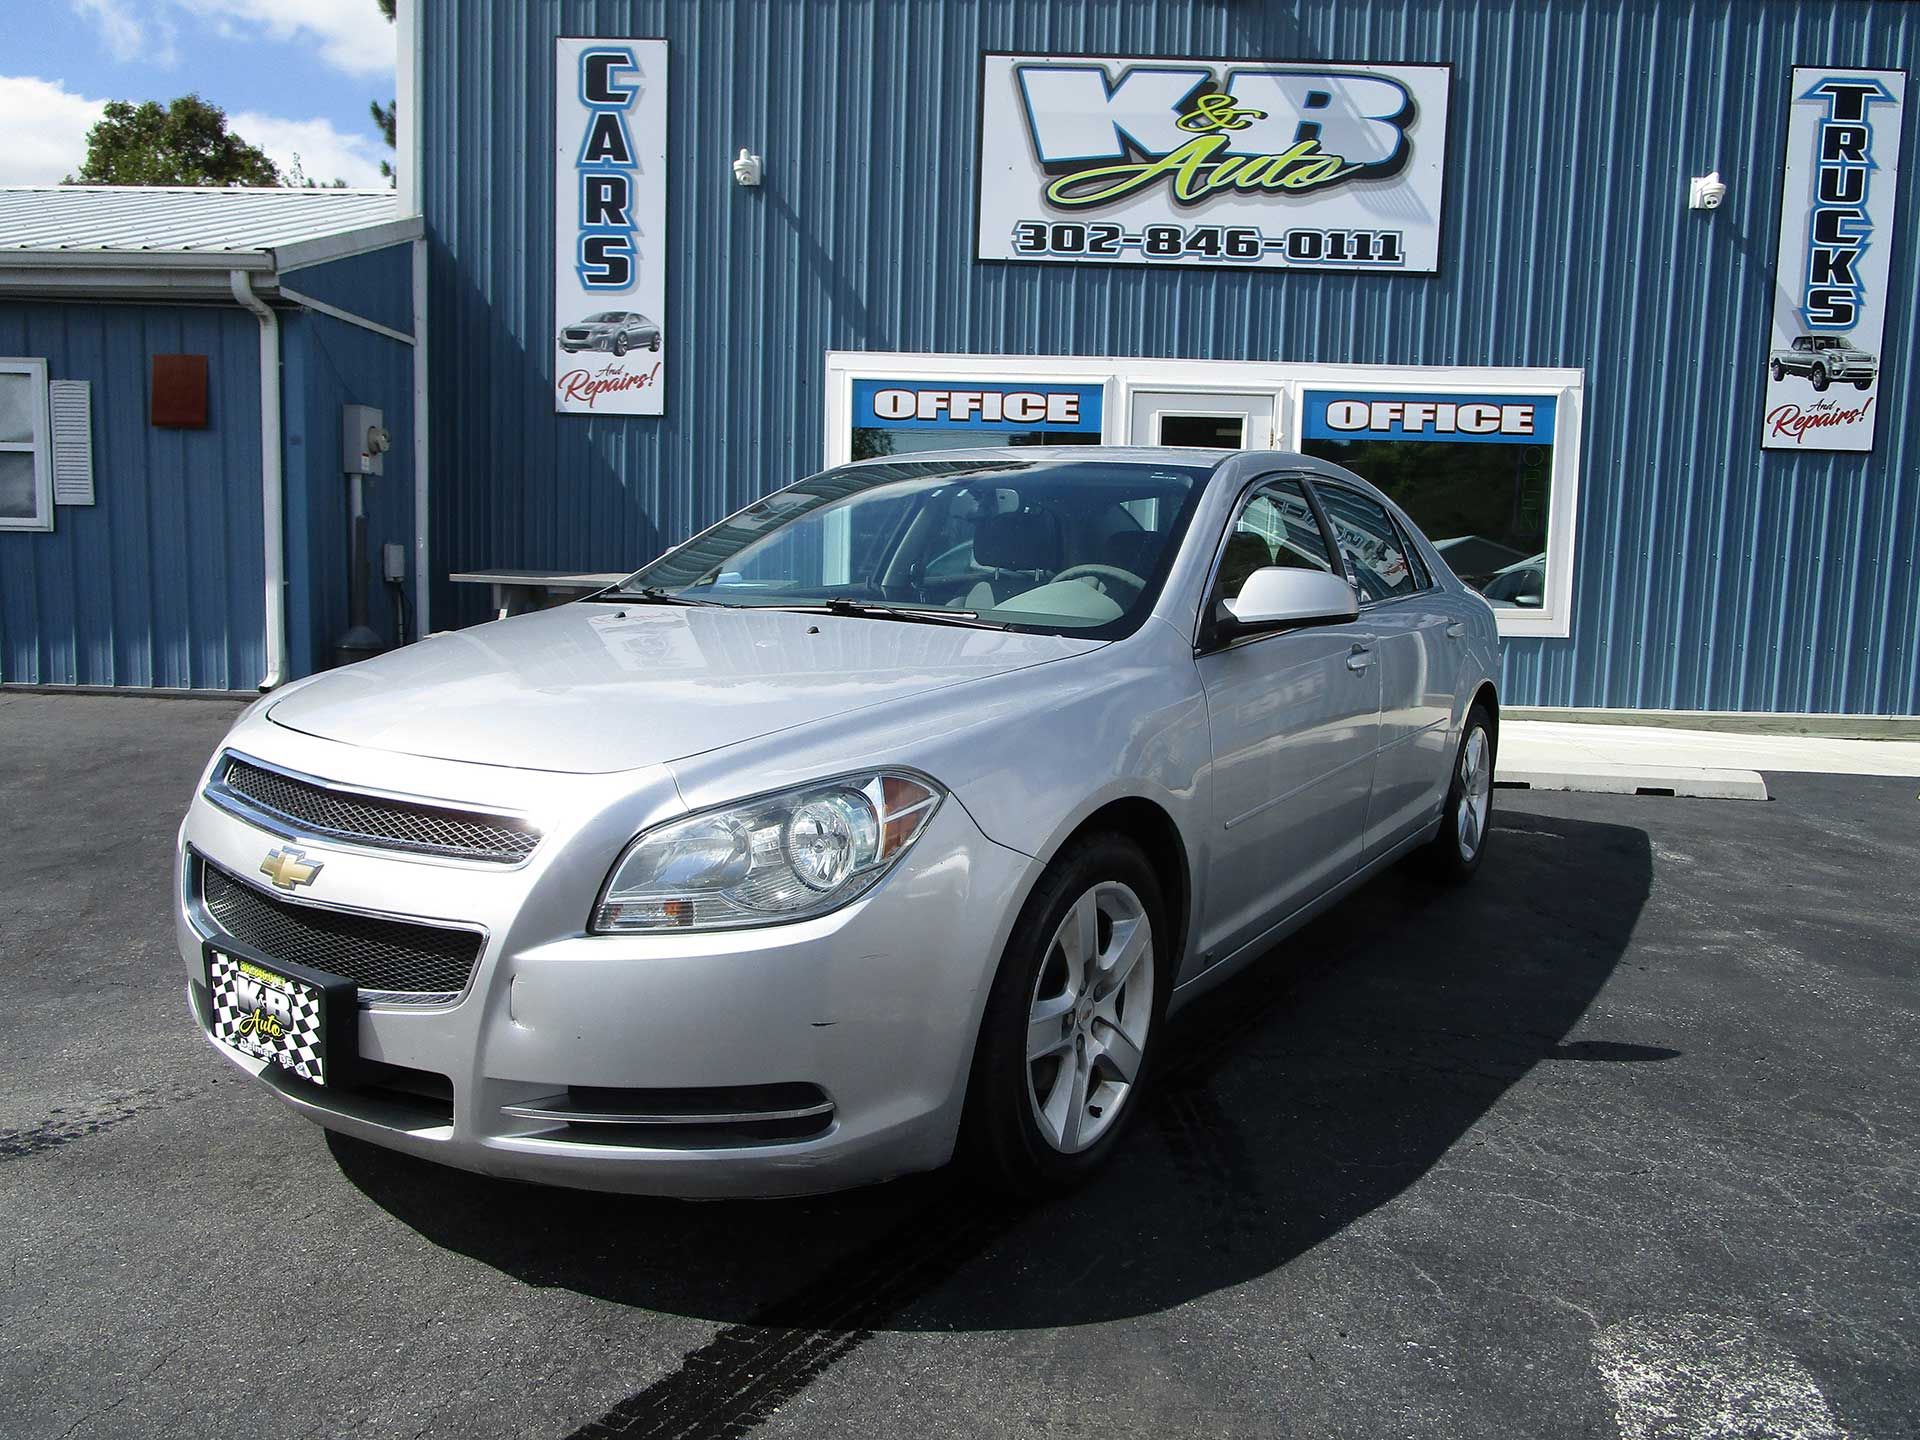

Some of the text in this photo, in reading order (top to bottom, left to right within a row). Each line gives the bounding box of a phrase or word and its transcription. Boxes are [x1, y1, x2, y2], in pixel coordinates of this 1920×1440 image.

[577, 47, 640, 291] CARS
[1046, 135, 1365, 207] Auto
[1797, 78, 1898, 330] TRUCKS
[1013, 220, 1405, 263] 302-846-0111
[557, 362, 661, 409] Repairs!
[596, 364, 624, 379] And
[873, 388, 1081, 425] OFFICE
[1325, 400, 1535, 436] OFFICE
[1767, 397, 1874, 443] Repairs!
[1806, 399, 1837, 413] And
[239, 1008, 284, 1037] Auto
